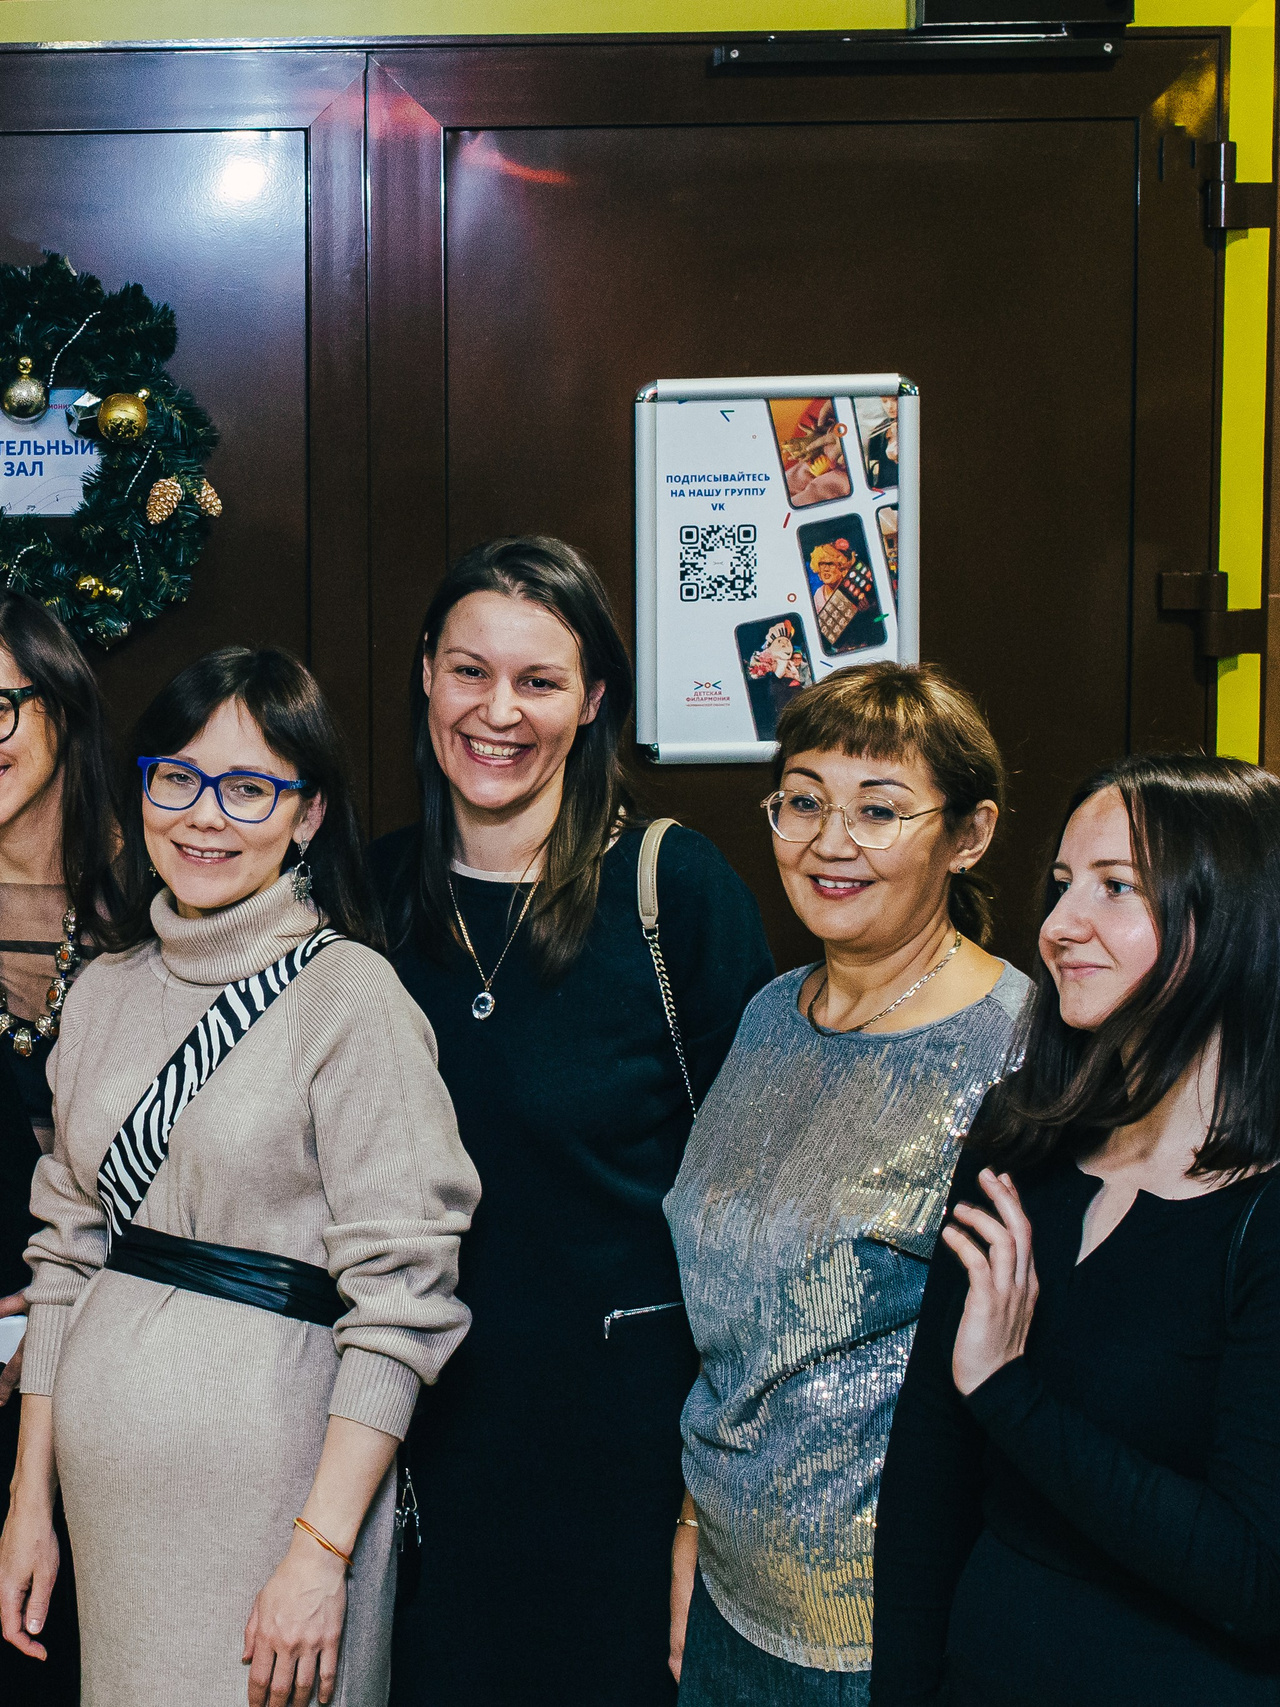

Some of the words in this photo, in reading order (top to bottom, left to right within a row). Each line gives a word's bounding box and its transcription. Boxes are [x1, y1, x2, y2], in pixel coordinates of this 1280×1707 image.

[3, 460, 44, 477] ЗАЛ
[666, 471, 770, 485] ПОДПИСЫВАЙТЕСЬ
[670, 489, 686, 498] НА
[688, 488, 721, 497] НАШУ
[724, 487, 766, 497] ГРУППУ
[711, 502, 725, 511] VK
